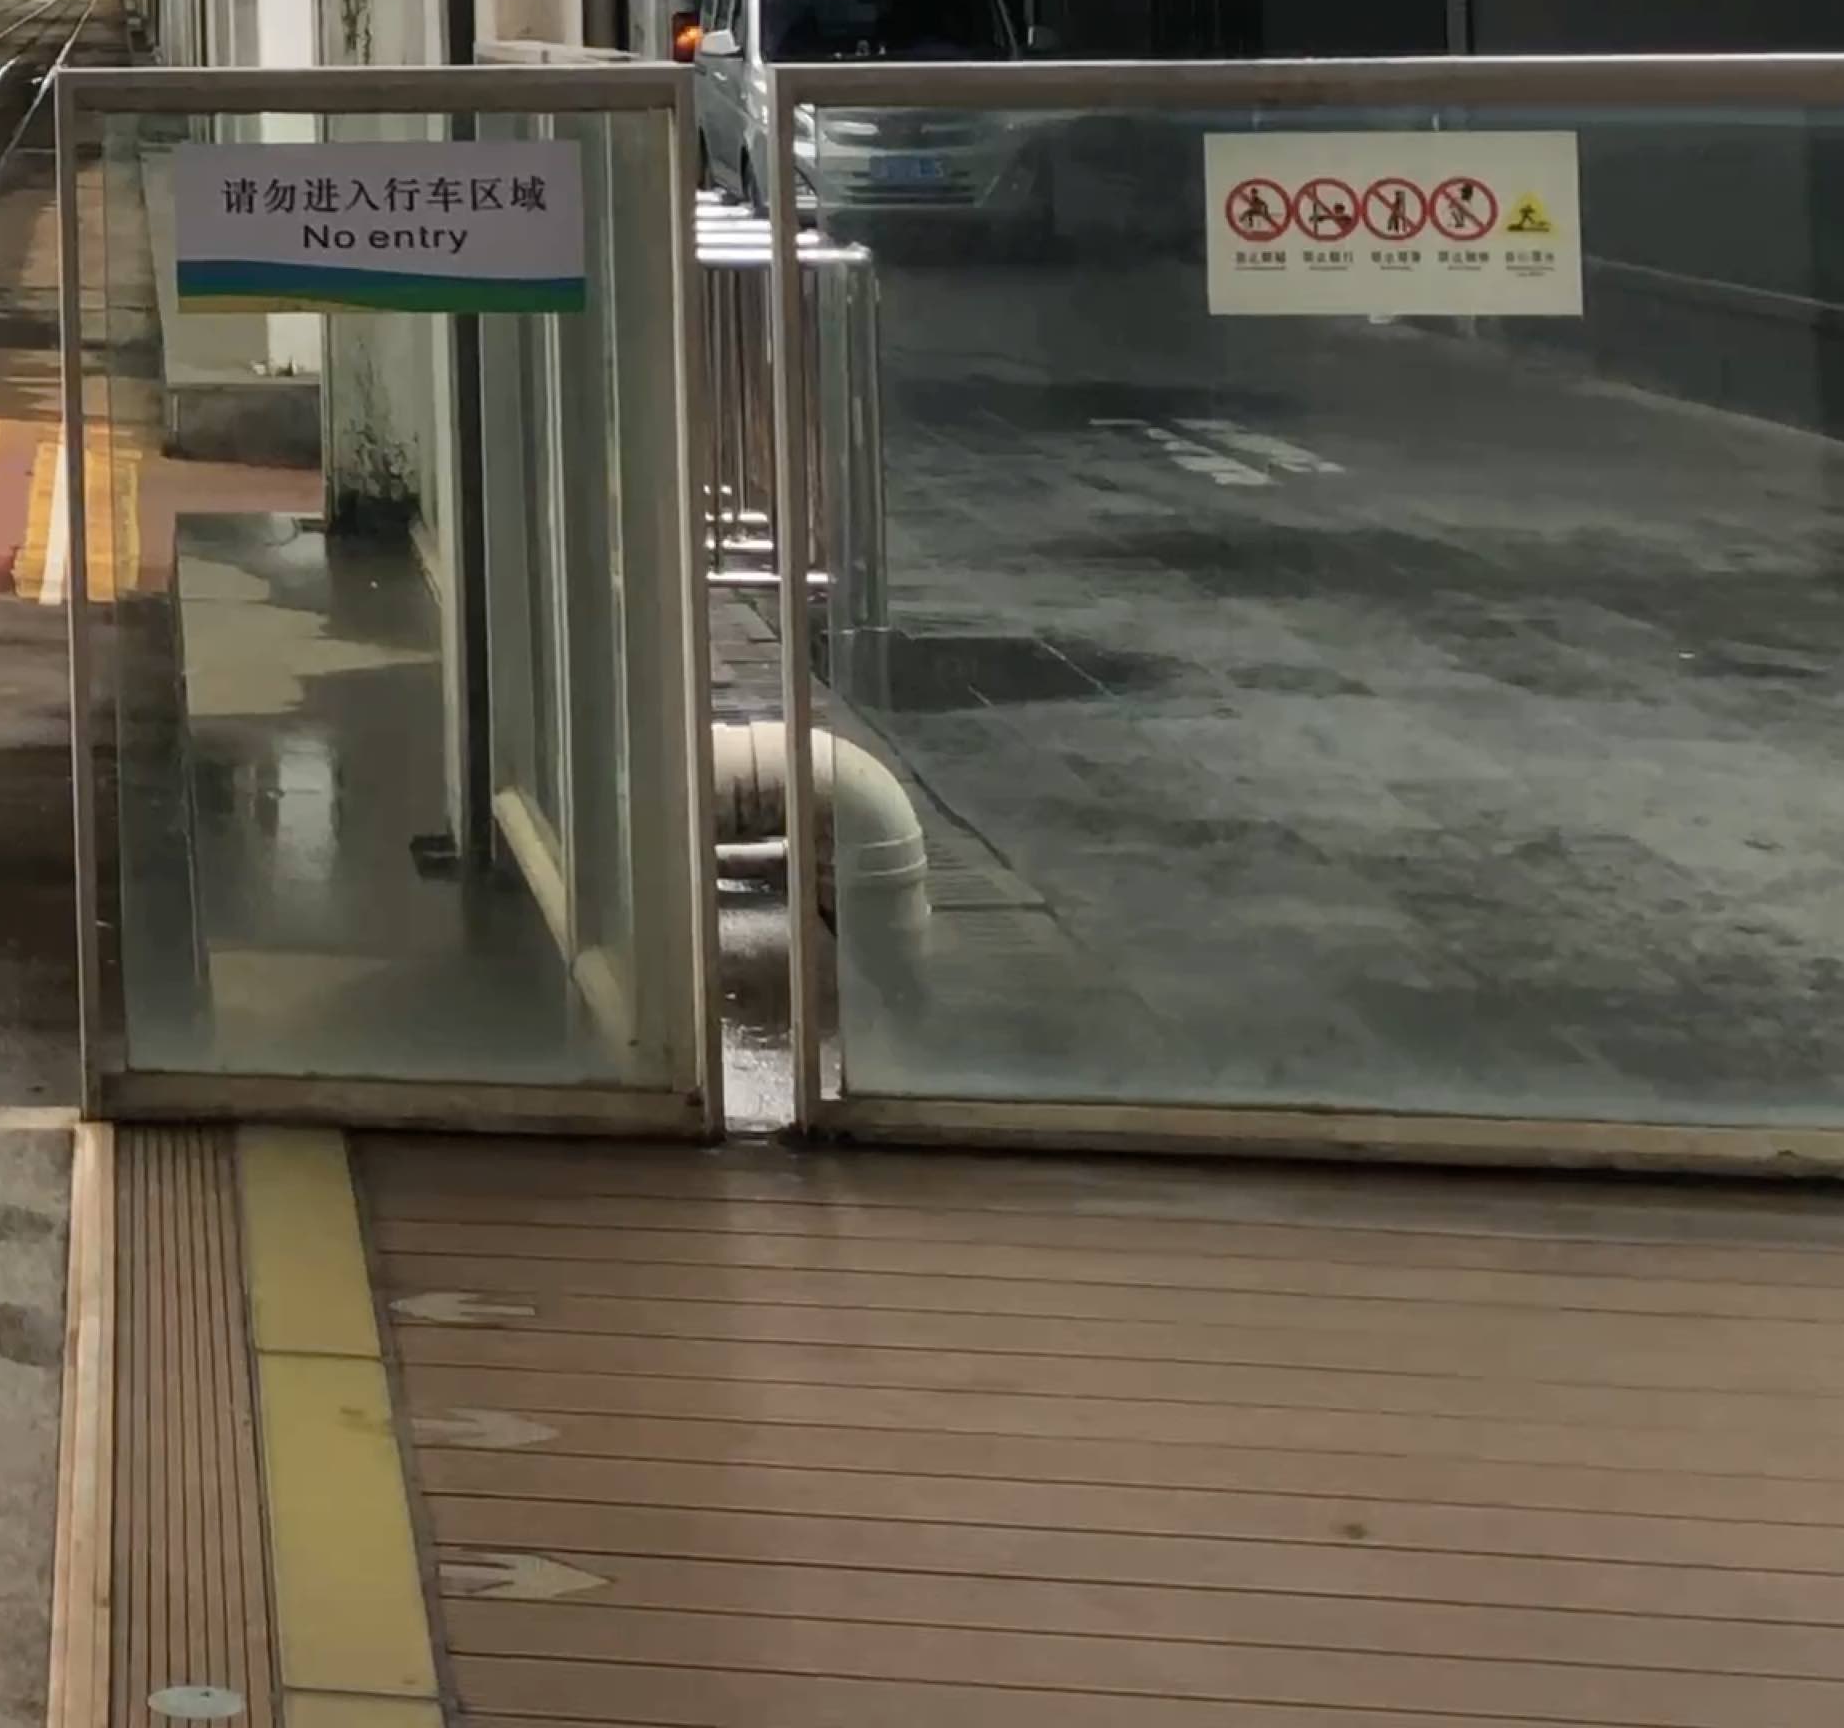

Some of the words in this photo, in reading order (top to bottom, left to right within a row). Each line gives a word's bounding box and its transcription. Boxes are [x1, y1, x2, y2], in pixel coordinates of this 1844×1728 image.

[223, 174, 549, 216] 请勿进入行车区域
[302, 223, 356, 251] No
[369, 223, 469, 255] entry
